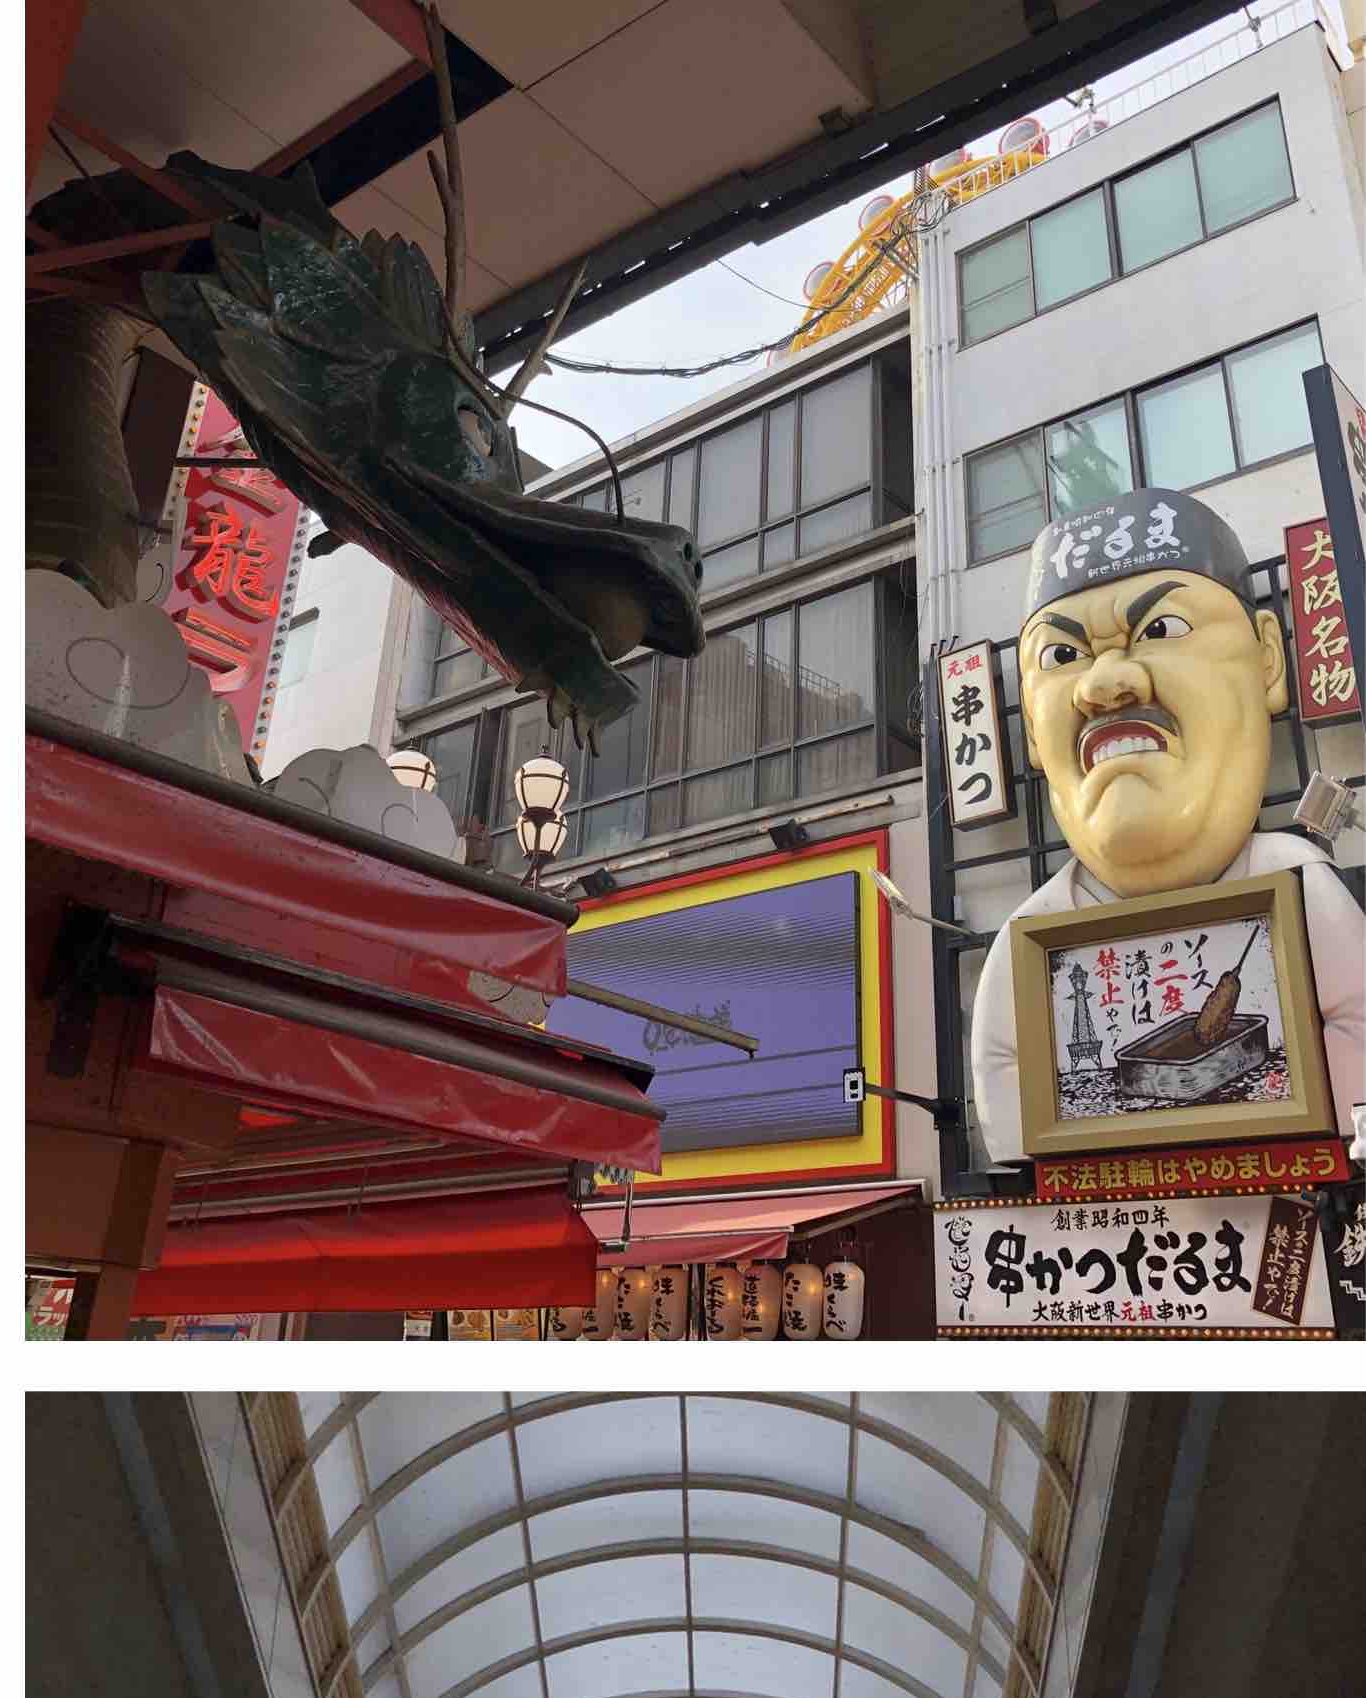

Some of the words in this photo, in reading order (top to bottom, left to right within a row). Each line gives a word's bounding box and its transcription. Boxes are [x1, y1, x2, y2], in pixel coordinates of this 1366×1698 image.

[1049, 501, 1181, 580] だるま
[1300, 529, 1357, 707] 大阪名物
[946, 654, 985, 680] 元祖
[950, 684, 993, 805] 串かつ
[1124, 949, 1156, 1025] 漬けは
[1153, 941, 1191, 1016] の二度
[1184, 933, 1214, 990] ソース
[1043, 1151, 1337, 1191] 不法駐輪はやめましょう
[1050, 1204, 1171, 1232] 創業昭和四年
[984, 1218, 1253, 1308] 串かつだるま
[1031, 1300, 1209, 1323] 大阪新世界元祖串かつ
